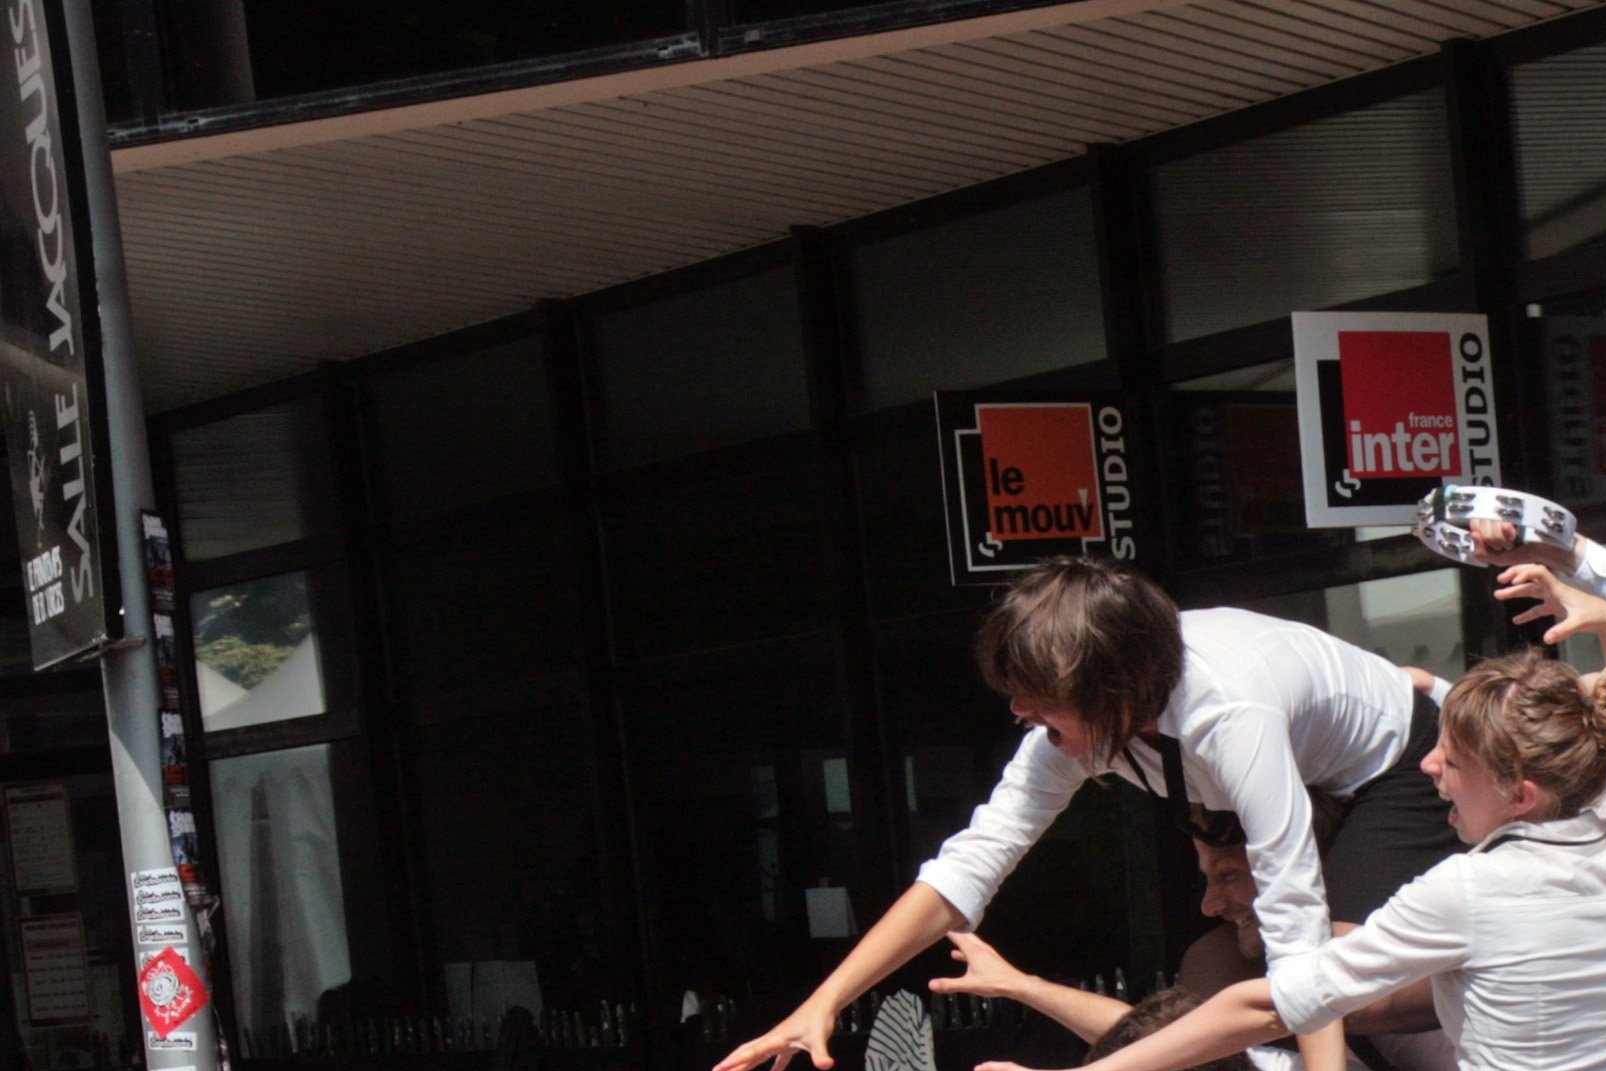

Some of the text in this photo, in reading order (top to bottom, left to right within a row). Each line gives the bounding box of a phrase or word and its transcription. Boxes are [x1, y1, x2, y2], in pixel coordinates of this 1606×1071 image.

[1349, 420, 1456, 474] inter
[1408, 412, 1453, 430] france
[55, 383, 94, 603] SALLE
[988, 457, 1024, 497] le
[1099, 406, 1136, 560] STUDIO
